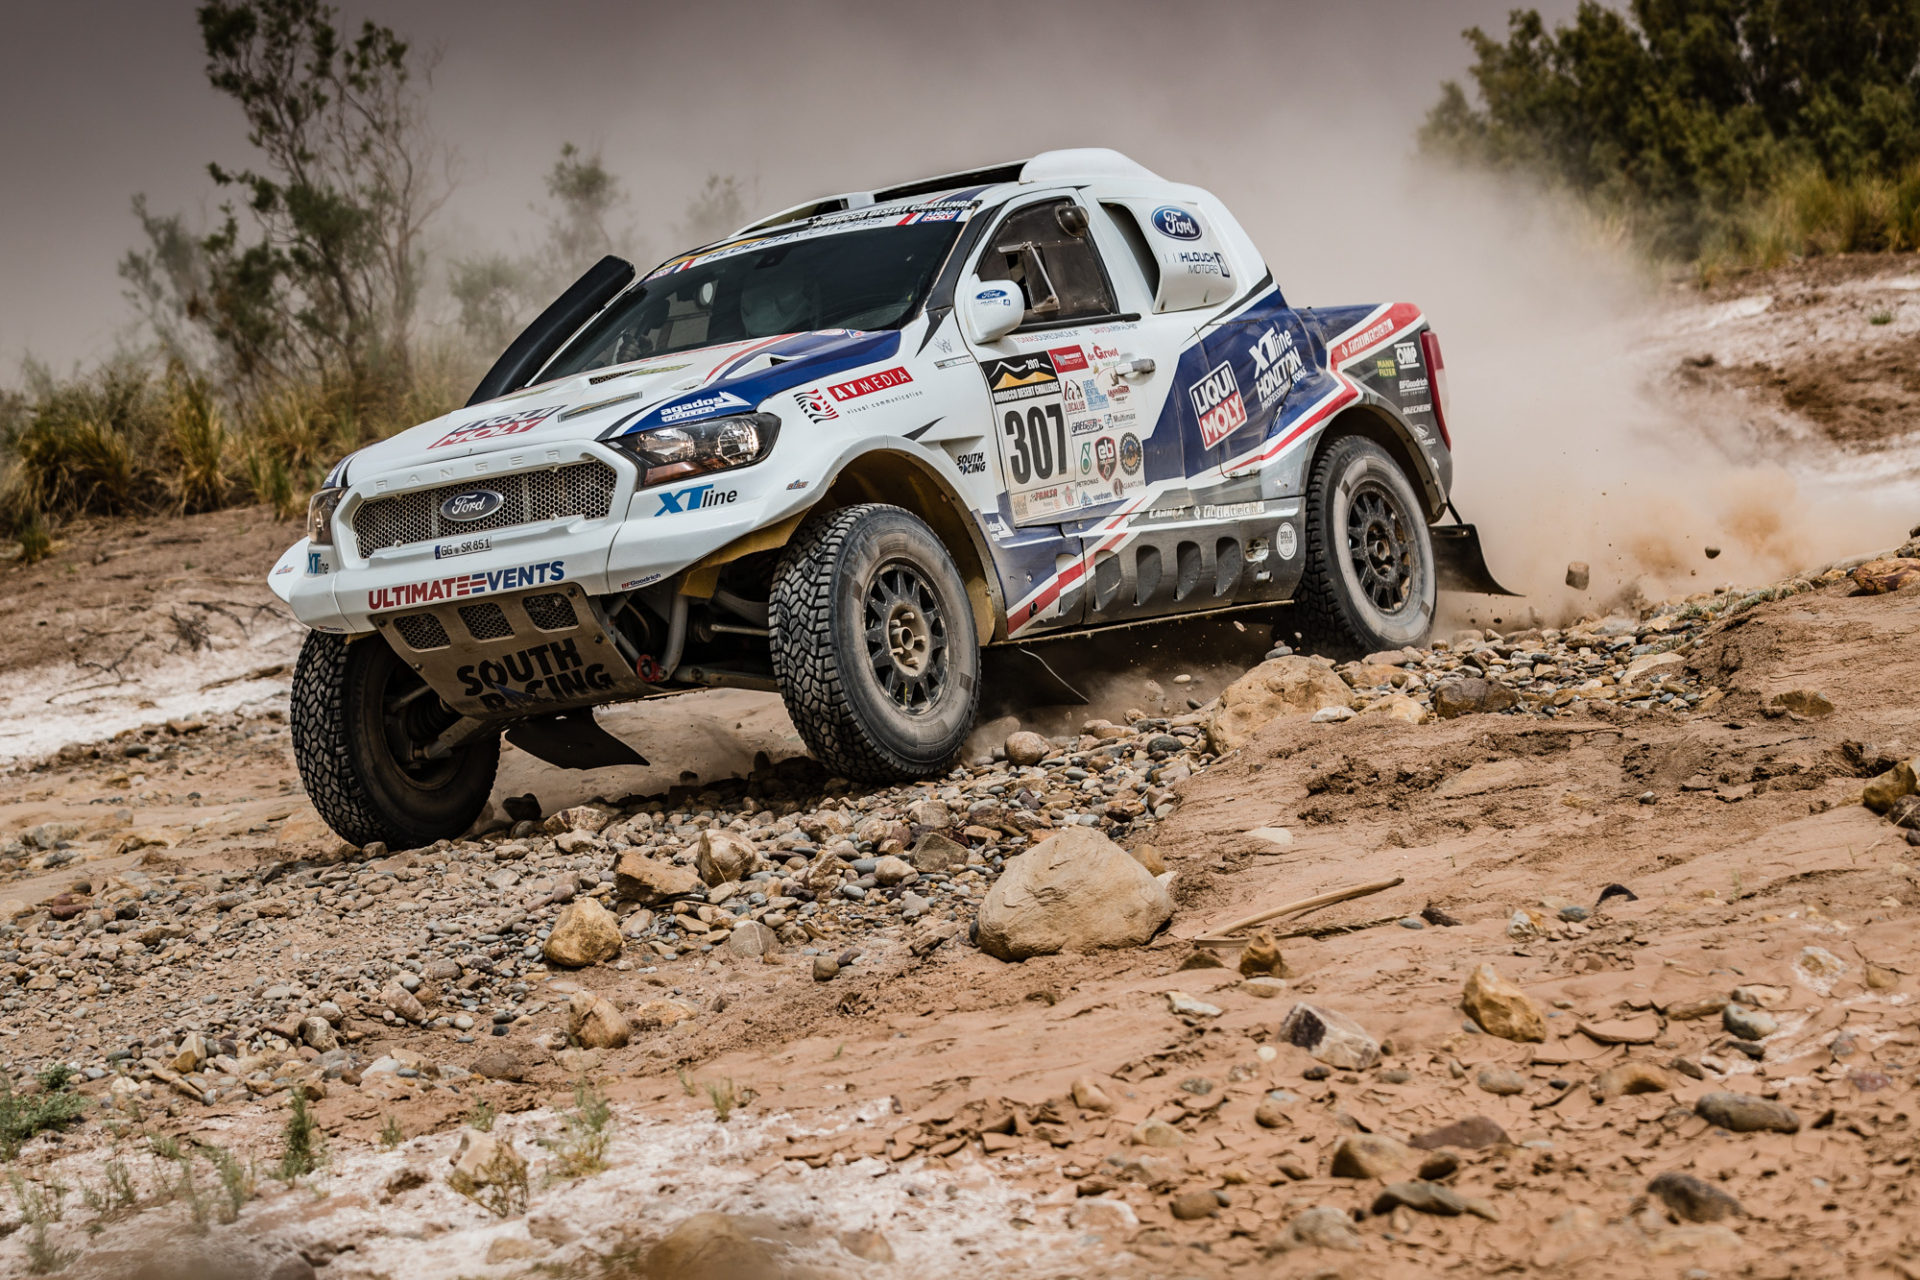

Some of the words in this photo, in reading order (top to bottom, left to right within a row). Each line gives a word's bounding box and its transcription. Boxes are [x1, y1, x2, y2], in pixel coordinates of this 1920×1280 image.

[1163, 209, 1196, 234] Ford
[1188, 264, 1219, 275] MOTORS
[1025, 358, 1040, 370] 2017
[1376, 359, 1395, 368] MANN
[1397, 347, 1418, 364] OMP
[1378, 368, 1397, 377] FILTER
[1193, 367, 1236, 415] LIQUI
[660, 396, 724, 416] agados
[1201, 394, 1242, 444] MOLY
[1004, 403, 1067, 484] 307
[375, 450, 561, 488] RANGER
[957, 452, 984, 466] SOUTH
[451, 494, 486, 515] Ford
[441, 545, 453, 557] GG
[456, 638, 583, 696] SOUTH
